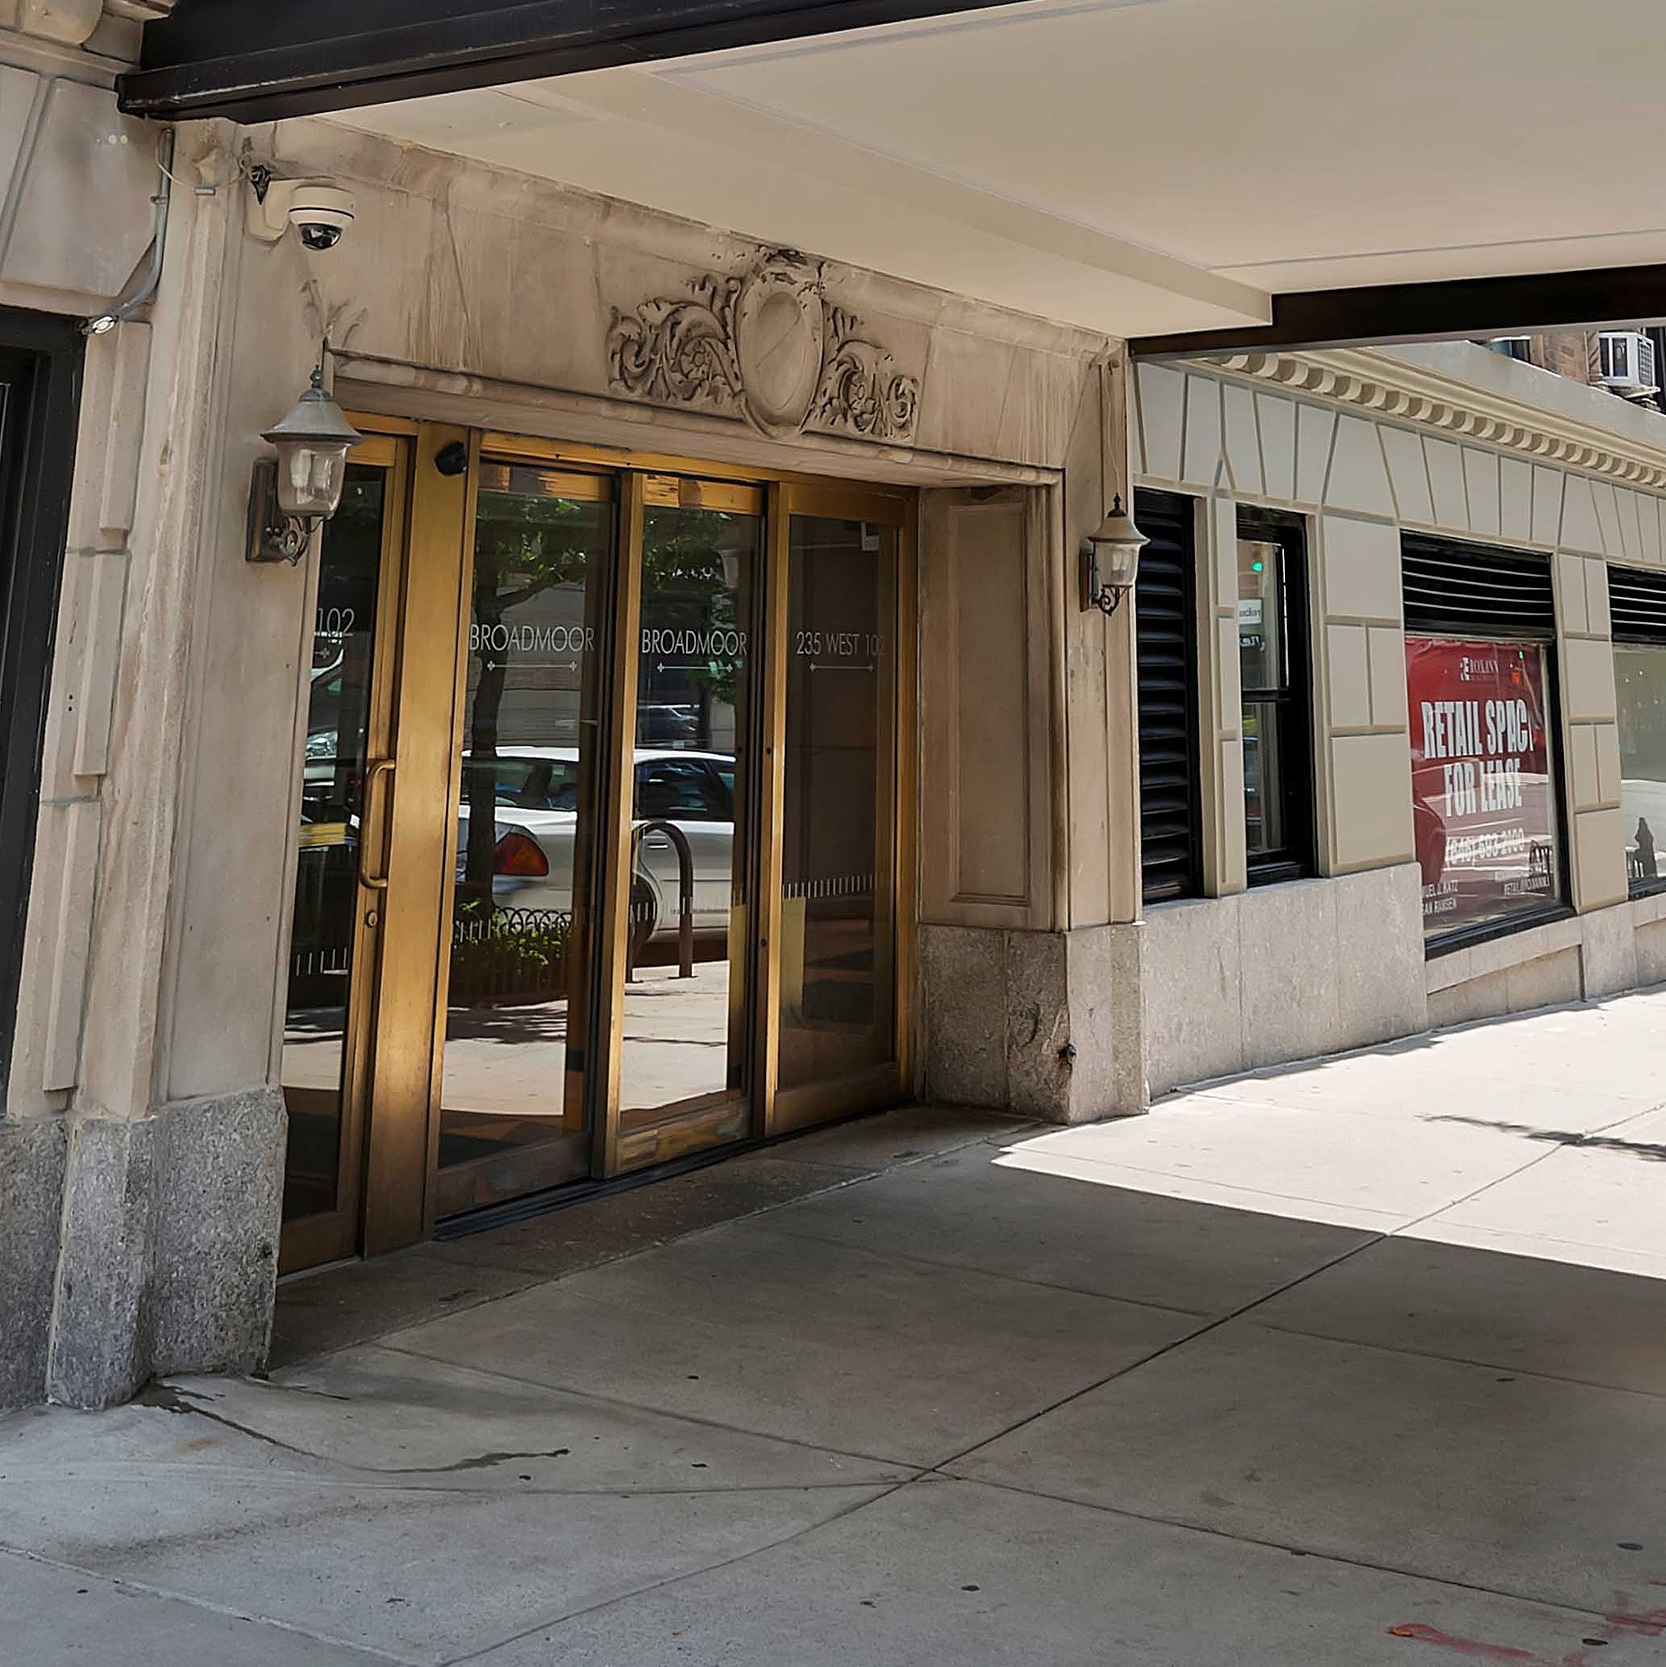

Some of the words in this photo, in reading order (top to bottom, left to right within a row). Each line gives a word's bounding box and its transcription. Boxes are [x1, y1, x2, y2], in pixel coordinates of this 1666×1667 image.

[318, 608, 355, 636] 102
[469, 623, 595, 653] BROADMOOR
[641, 629, 748, 655] BROADMOOR
[796, 632, 821, 655] 235
[824, 633, 859, 656] WEST
[1421, 700, 1483, 759] RETAIL
[1444, 762, 1476, 817] FOR
[1479, 758, 1522, 813] LEASE
